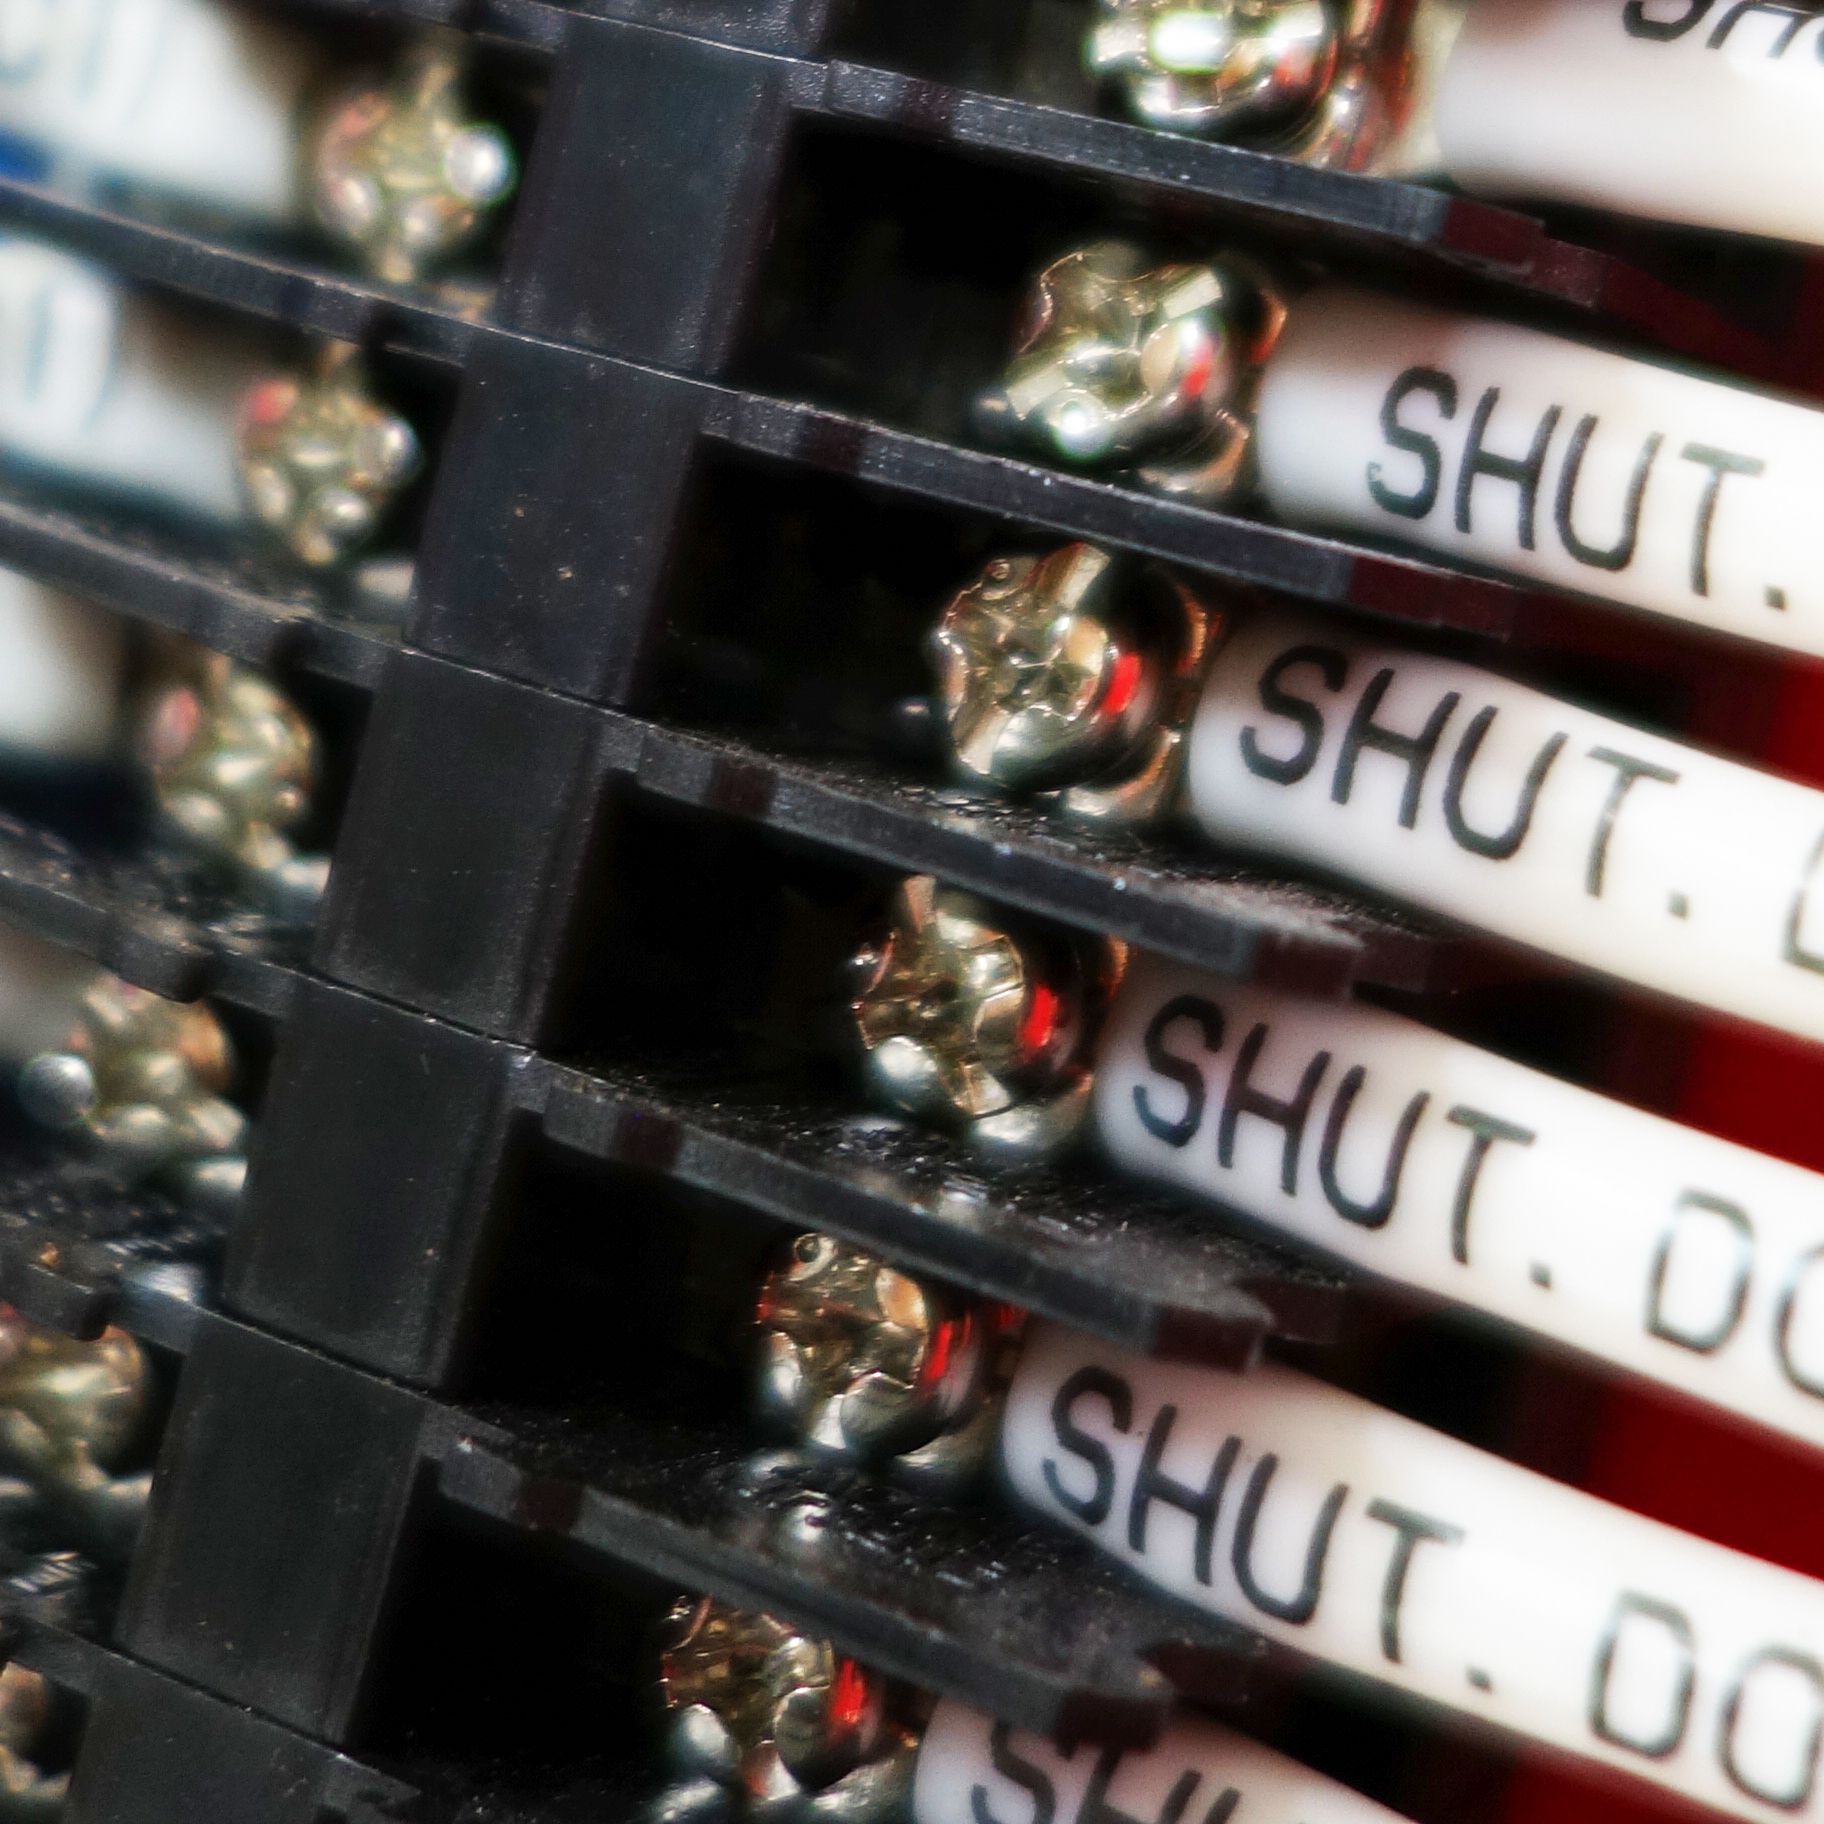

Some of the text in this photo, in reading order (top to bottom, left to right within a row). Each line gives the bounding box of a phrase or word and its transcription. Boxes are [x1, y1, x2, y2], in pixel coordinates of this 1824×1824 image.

[1366, 364, 1789, 612] SHUT.
[1236, 642, 1692, 921] SHUT.
[1130, 994, 1554, 1291] SHUT.
[1038, 1363, 1495, 1694] SHUT.
